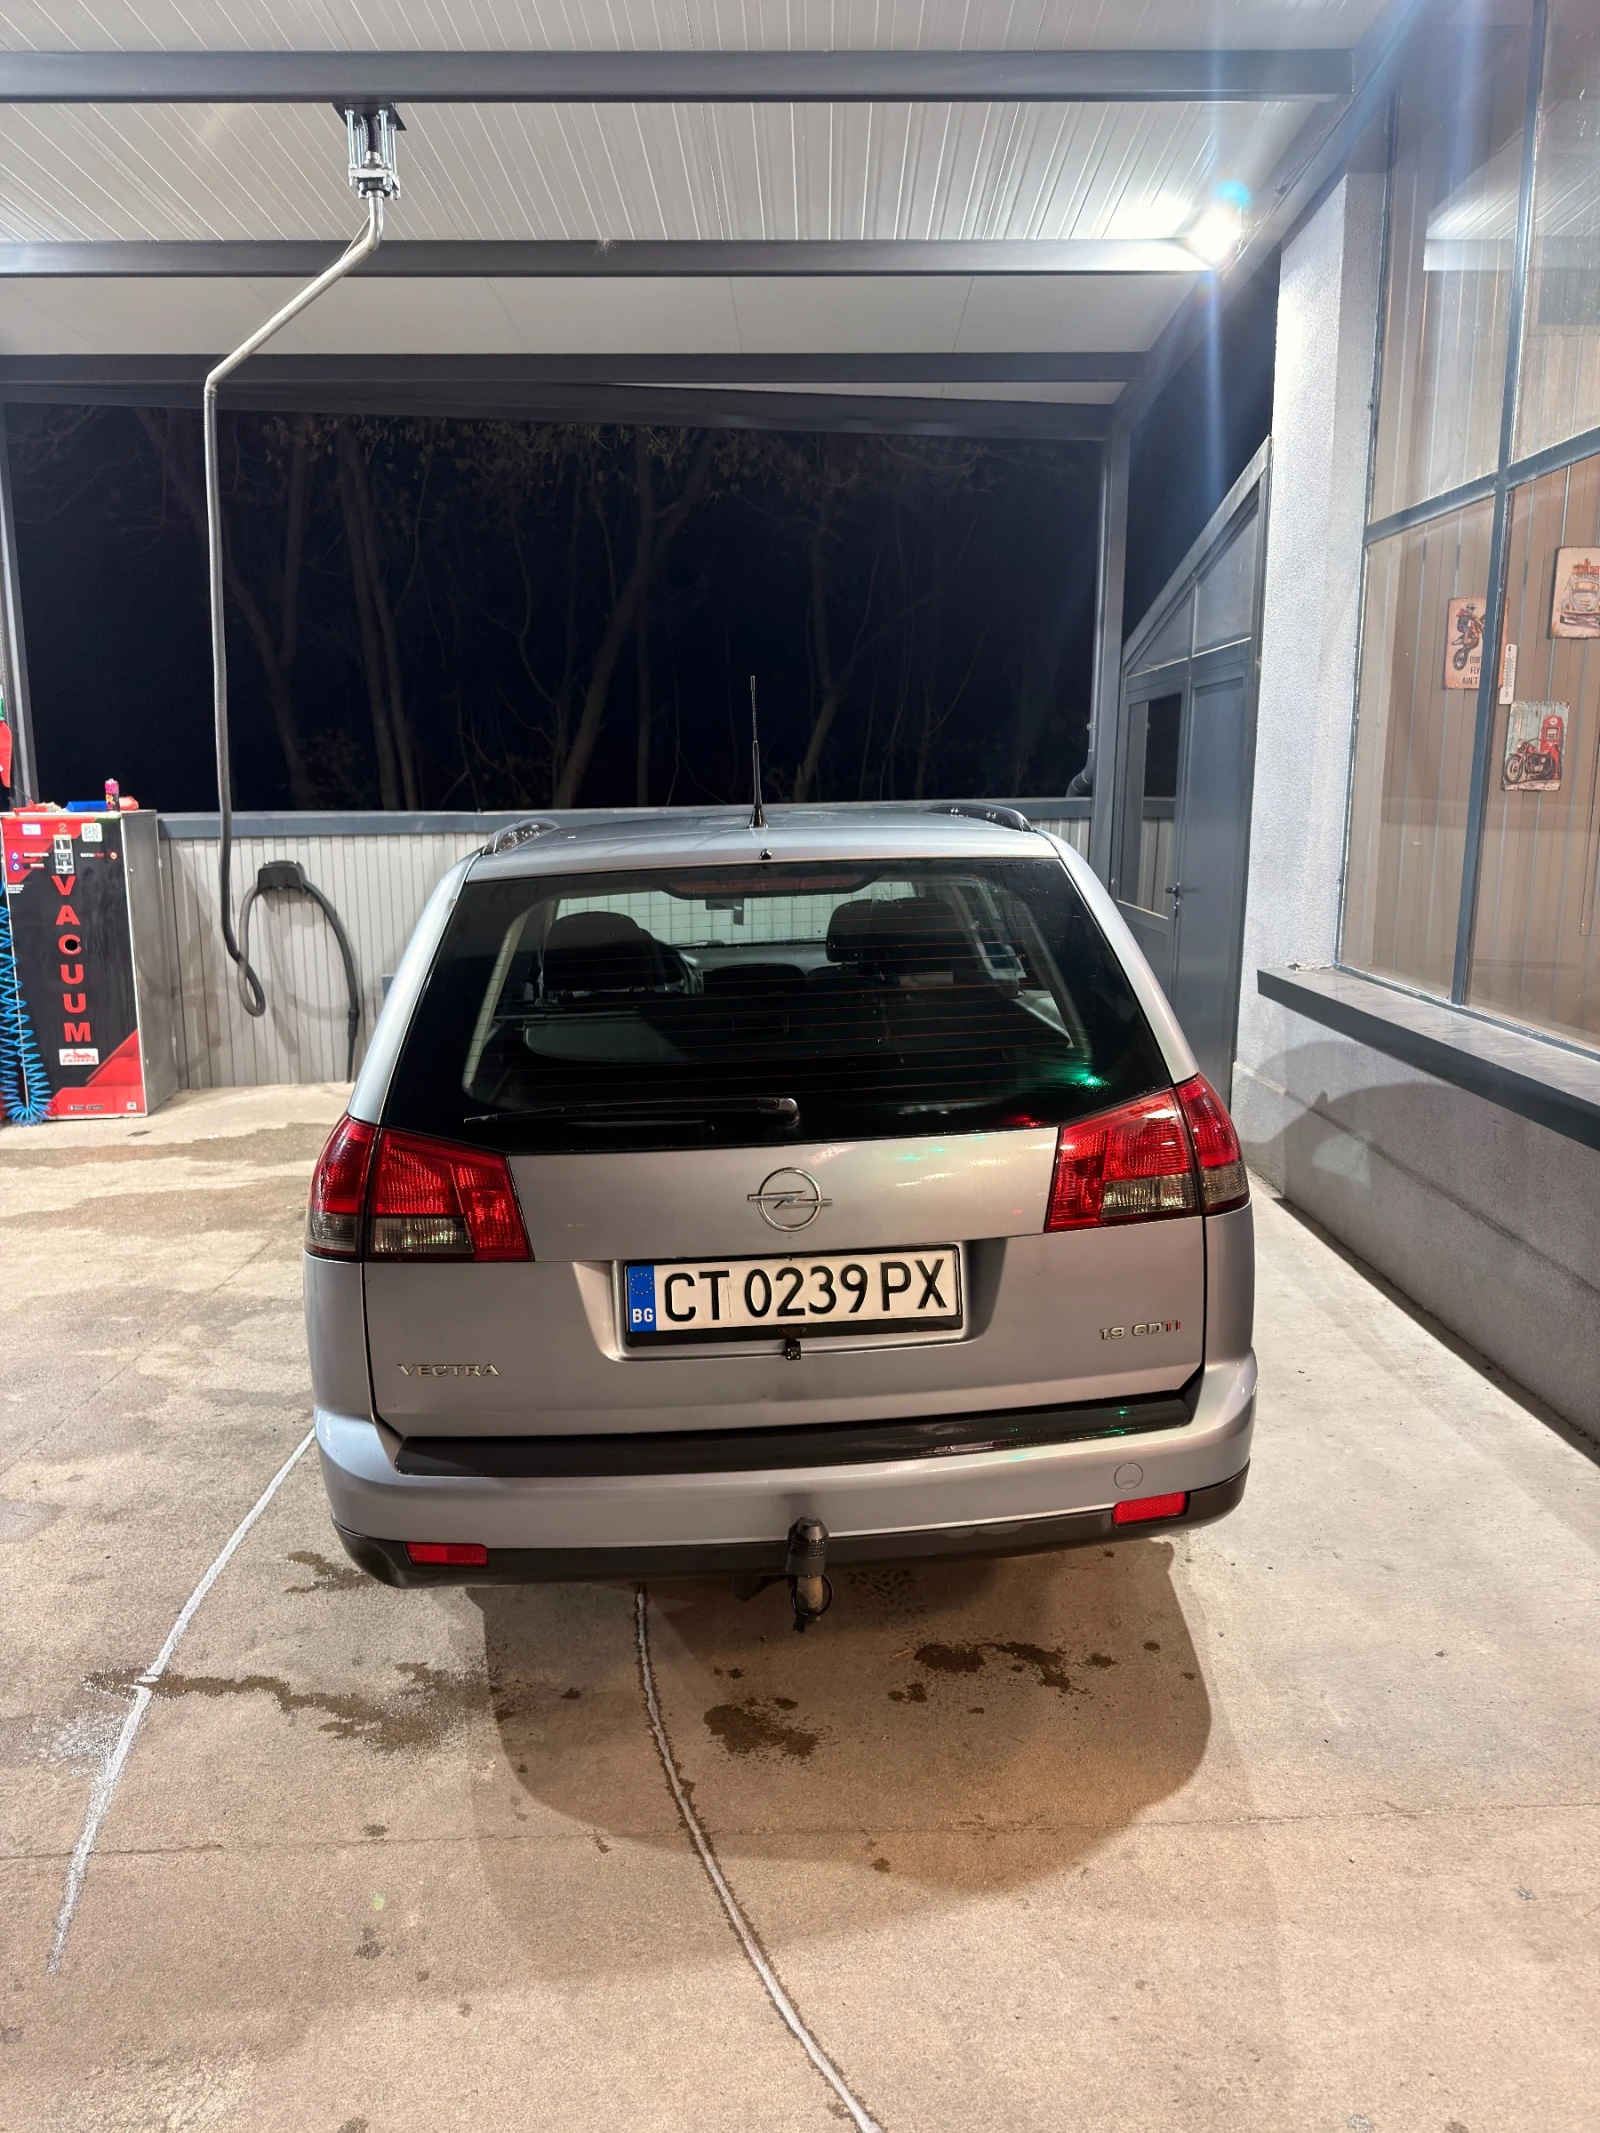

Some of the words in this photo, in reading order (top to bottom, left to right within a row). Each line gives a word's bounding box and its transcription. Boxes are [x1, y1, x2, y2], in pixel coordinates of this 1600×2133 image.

[58, 822, 67, 833] 2
[51, 875, 92, 1043] VACUUM
[664, 1270, 730, 1323] CT
[744, 1263, 869, 1318] 0239
[879, 1258, 948, 1311] PX
[632, 1308, 654, 1324] BG
[1100, 1326, 1125, 1340] 1.9
[397, 1363, 500, 1378] VECTRA
